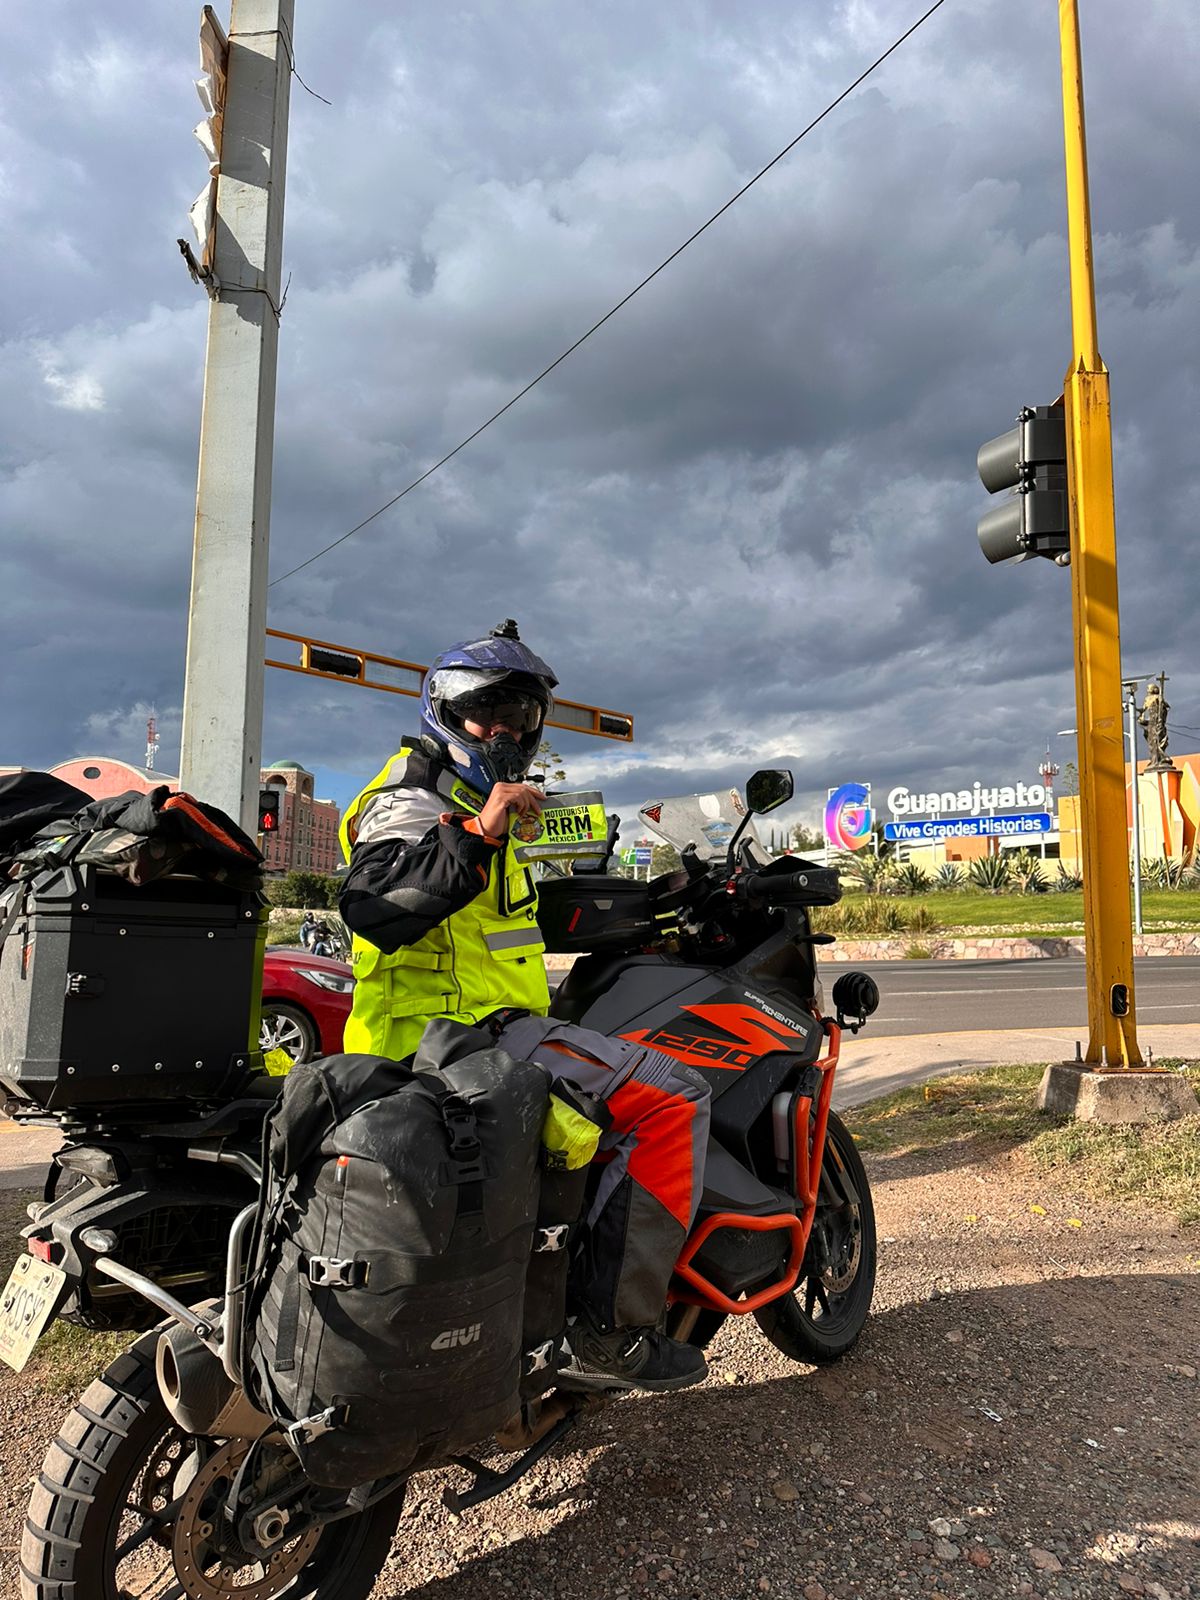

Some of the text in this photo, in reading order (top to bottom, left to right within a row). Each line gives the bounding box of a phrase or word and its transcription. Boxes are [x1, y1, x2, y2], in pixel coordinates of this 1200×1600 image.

[887, 781, 1045, 816] Guanajuato
[544, 806, 589, 819] MOTOTURISTA
[545, 814, 592, 836] RRM
[894, 817, 1042, 838] Vive Grandes Historias
[743, 991, 808, 1037] SUPER ADVENTURE
[641, 1029, 761, 1066] 1290
[430, 1323, 482, 1350] GIVI
